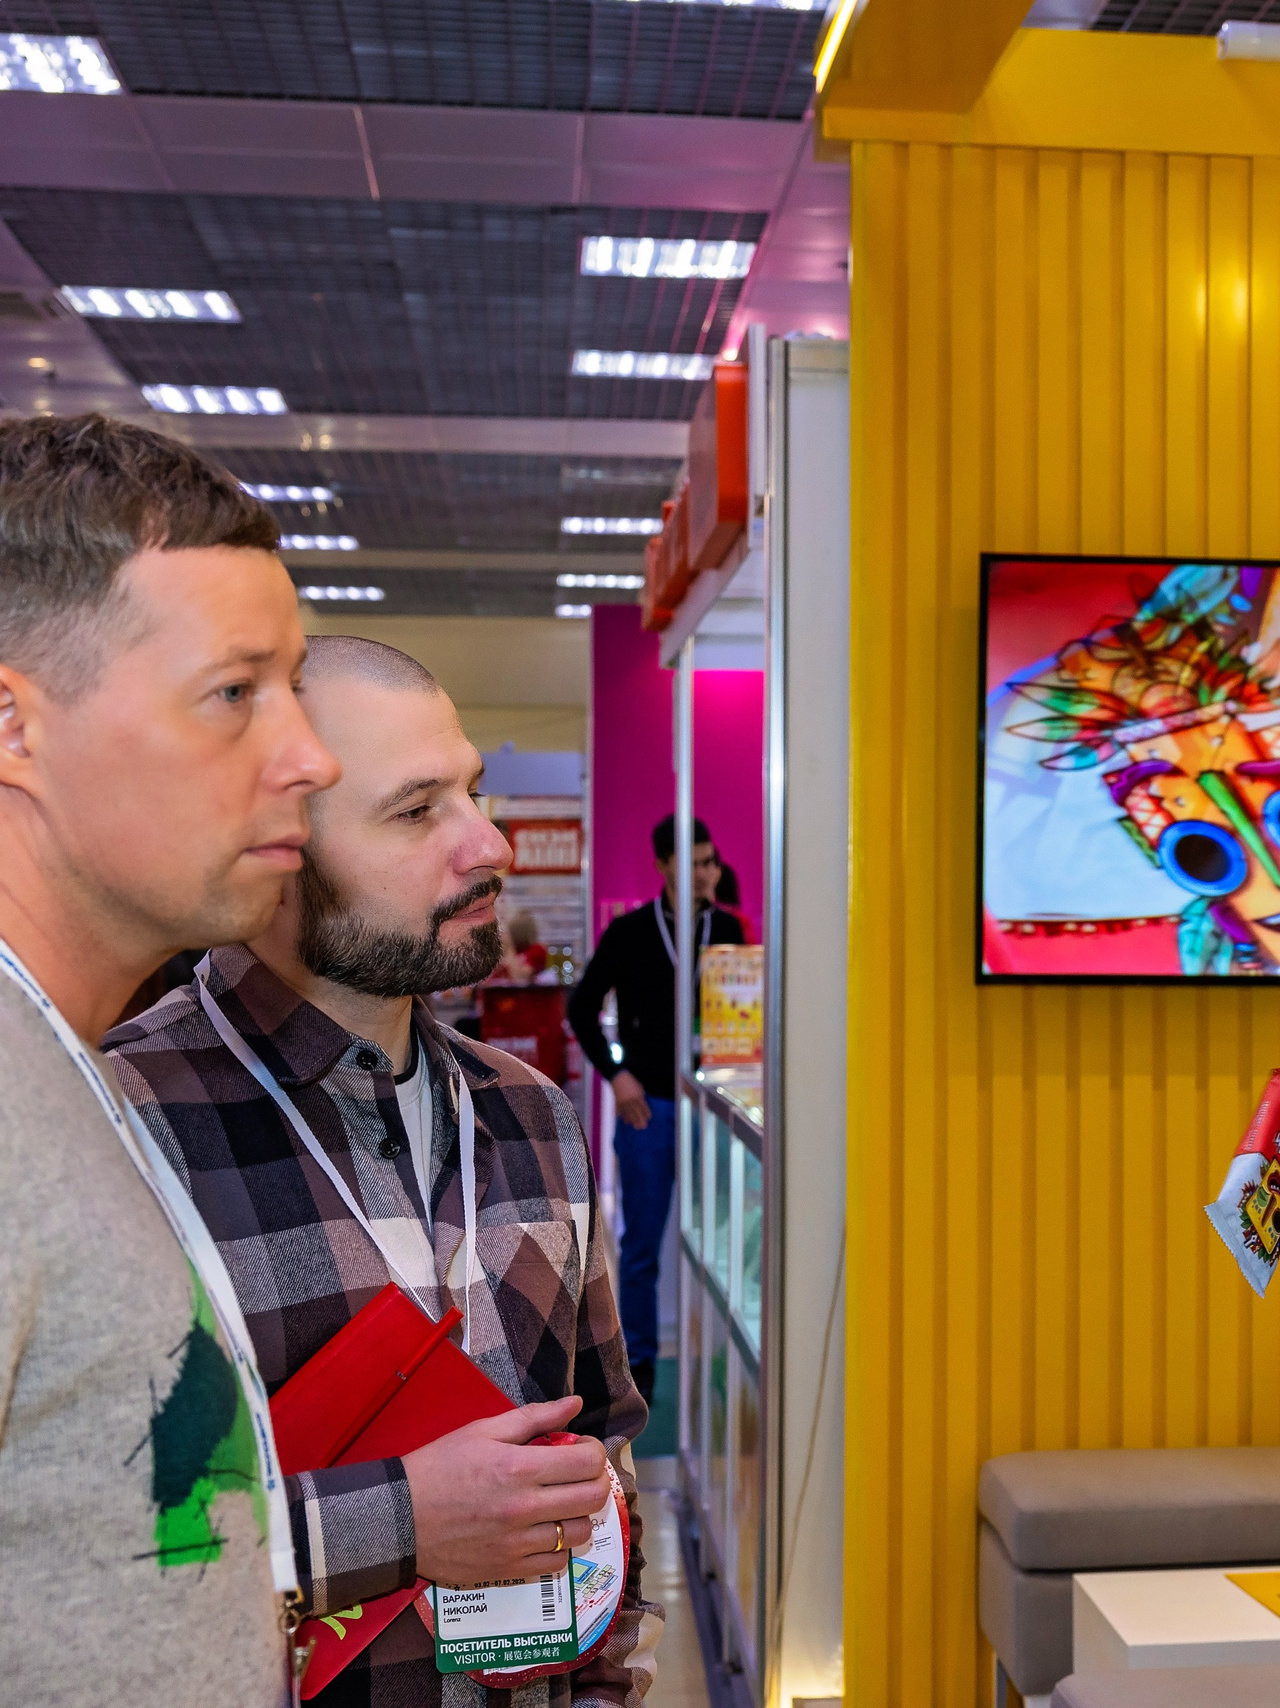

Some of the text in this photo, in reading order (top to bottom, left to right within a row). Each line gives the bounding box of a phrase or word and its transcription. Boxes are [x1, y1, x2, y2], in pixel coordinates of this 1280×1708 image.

[443, 1592, 485, 1604] ВАРАКИН
[443, 1603, 488, 1616] НИКОЛАЙ
[440, 1639, 512, 1654] ПОСЕТИТЕЛЬ
[513, 1632, 573, 1648] ВЫСТАВКИ
[454, 1646, 561, 1665] VISITOR 展览会参观者
